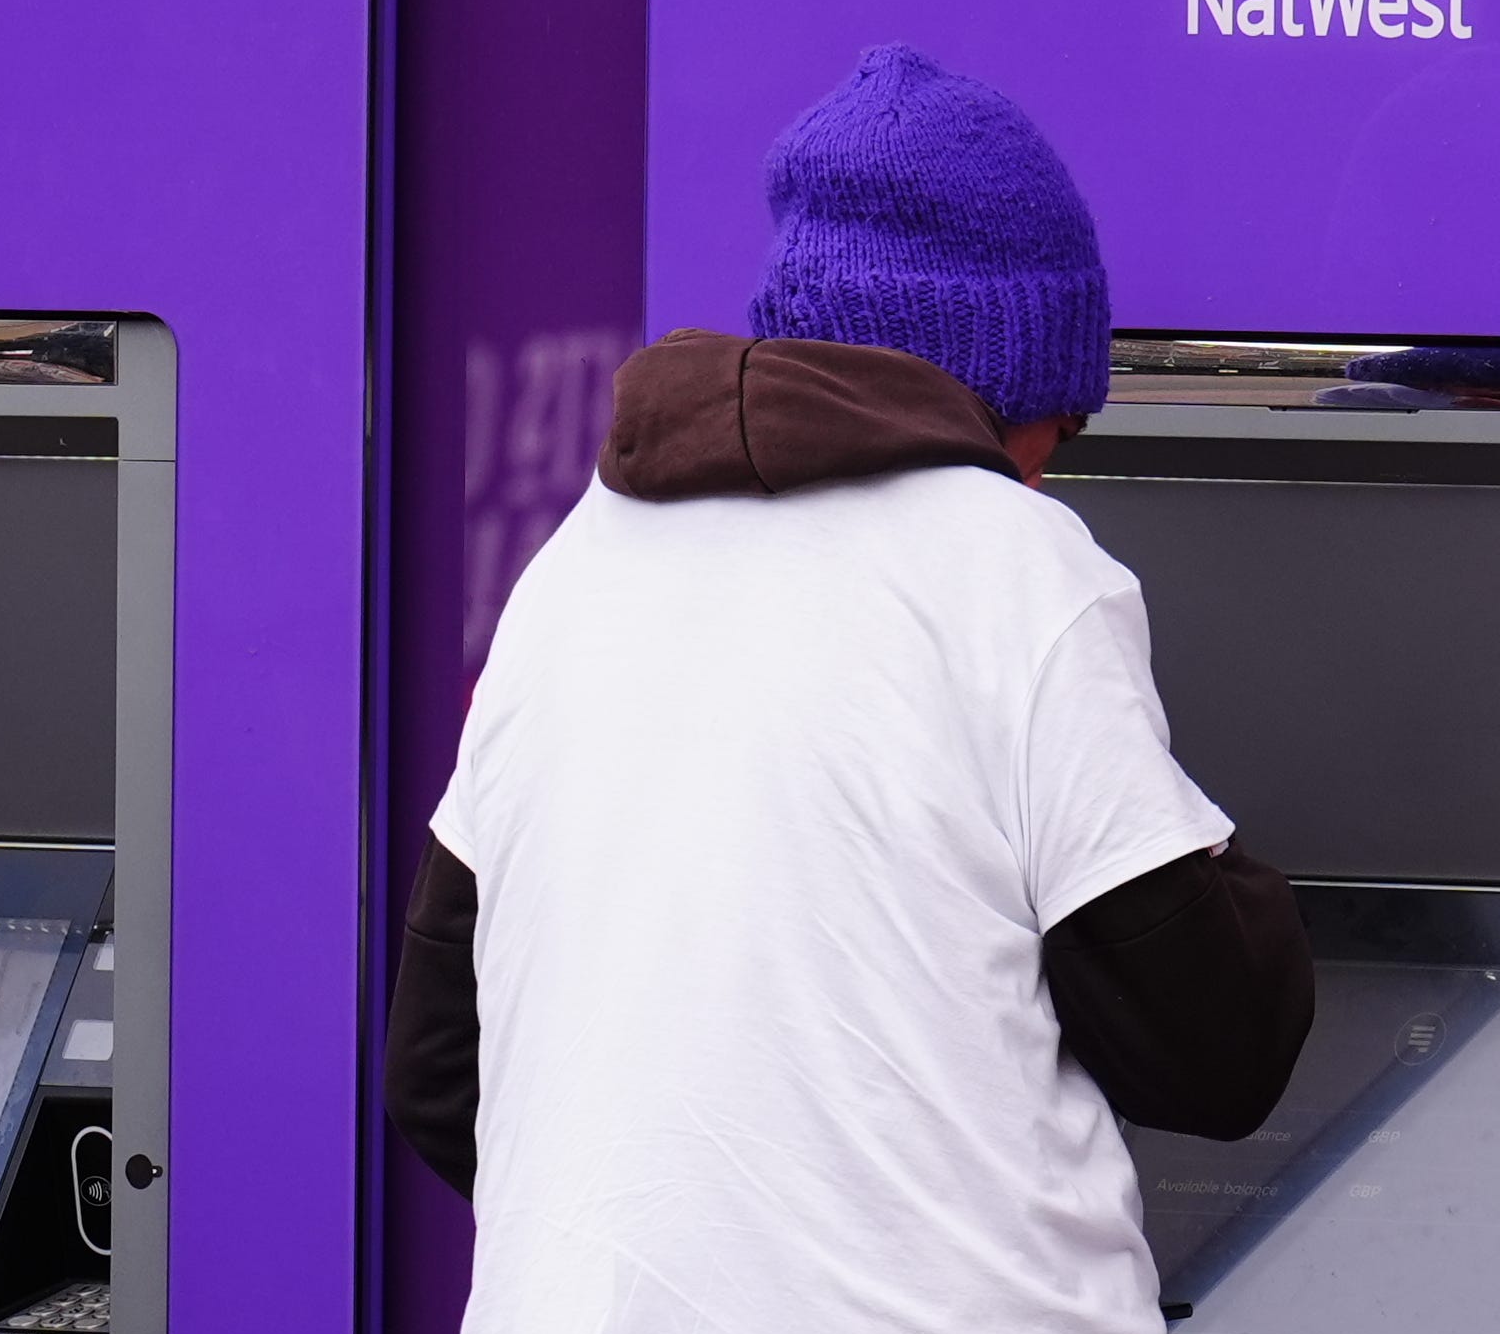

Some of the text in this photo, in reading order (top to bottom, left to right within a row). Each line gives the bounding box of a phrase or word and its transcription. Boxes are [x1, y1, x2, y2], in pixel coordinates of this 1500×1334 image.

[1246, 1129, 1292, 1142] lance
[1368, 1130, 1401, 1144] GBP
[1156, 1178, 1220, 1194] Available
[1223, 1181, 1279, 1197] balance
[1349, 1184, 1382, 1198] GBP
